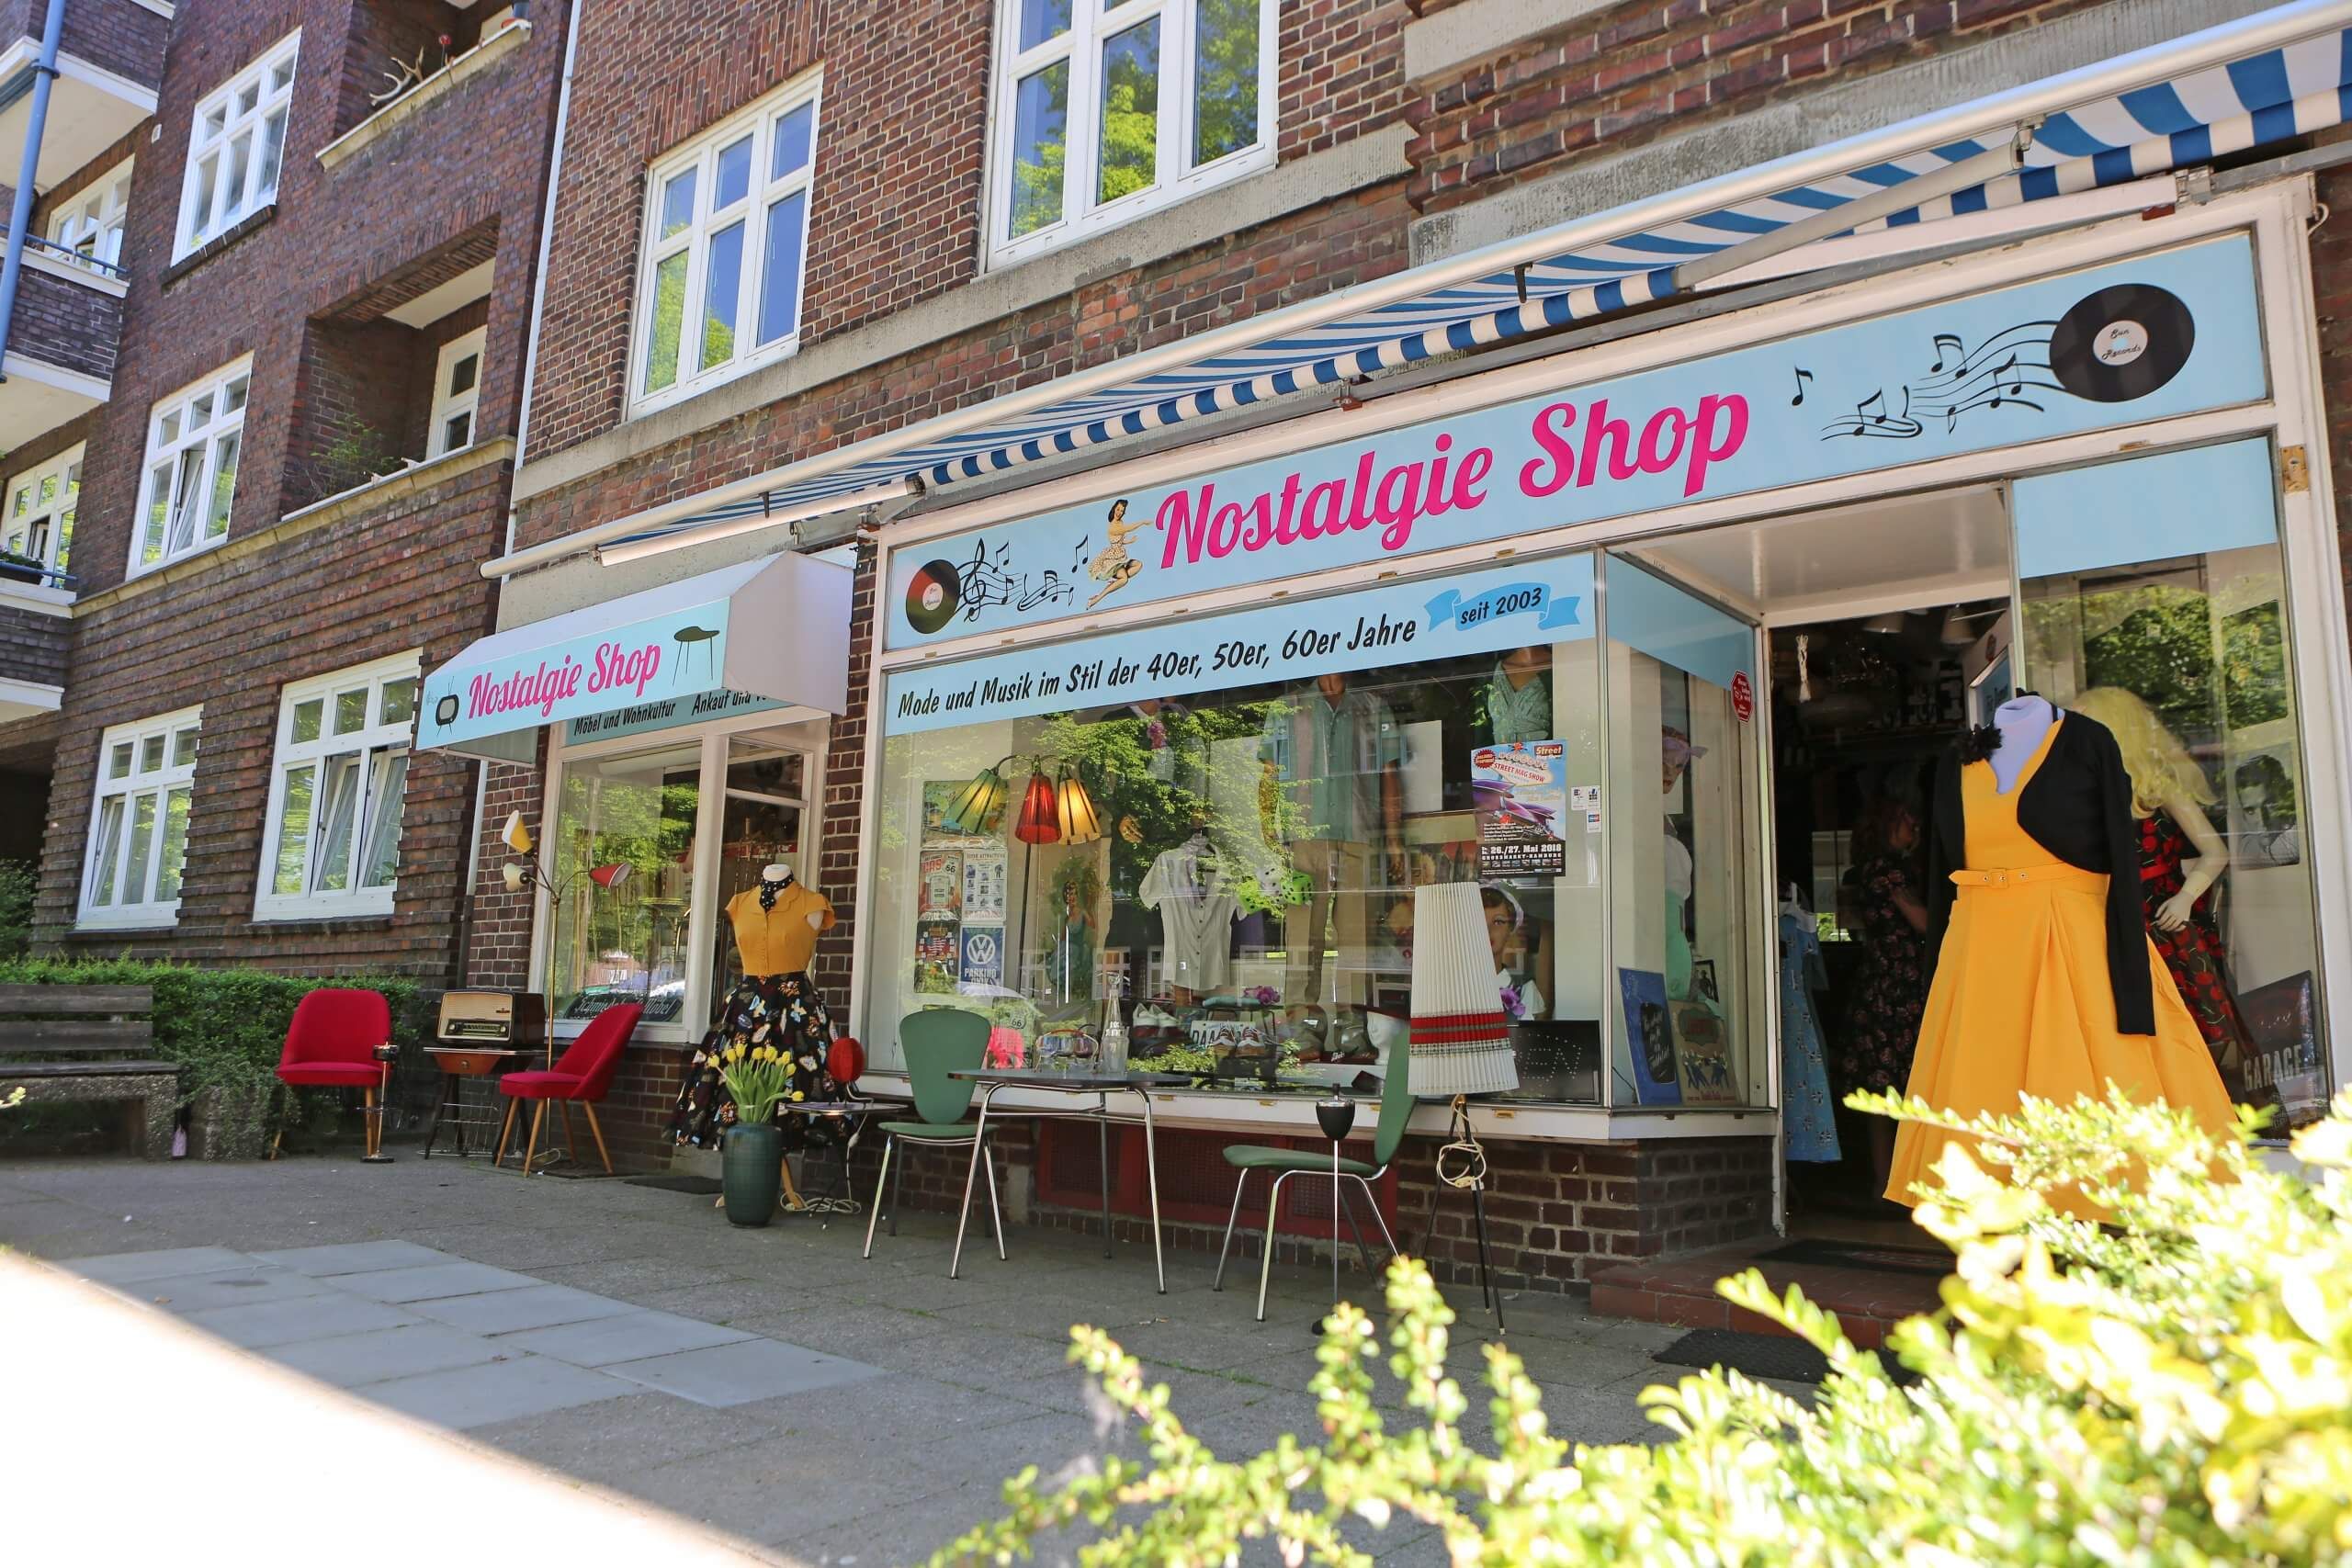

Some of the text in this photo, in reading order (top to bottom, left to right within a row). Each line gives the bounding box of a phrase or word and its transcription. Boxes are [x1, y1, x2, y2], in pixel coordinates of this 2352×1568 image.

[2101, 344, 2141, 360] Records
[1155, 393, 1750, 570] Nostalgie Shop
[1460, 587, 1543, 625] seit 2003
[898, 613, 1417, 718] Mode und Musik im Stil der 40er, 50er, 60er Jahre
[469, 642, 662, 718] Nostalgie Shop
[691, 689, 731, 716] Ankauf
[573, 701, 677, 736] Möbel und Wohnkultur
[1535, 746, 1563, 754] Street
[1494, 763, 1515, 773] STREET
[1515, 768, 1529, 778] MAG
[1528, 773, 1545, 784] SHOW
[1522, 844, 1538, 853] Mai
[1541, 843, 1562, 852] 2018
[945, 864, 956, 873] 66
[1011, 1019, 1023, 1027] 66
[2245, 1044, 2304, 1091] GARAGE
